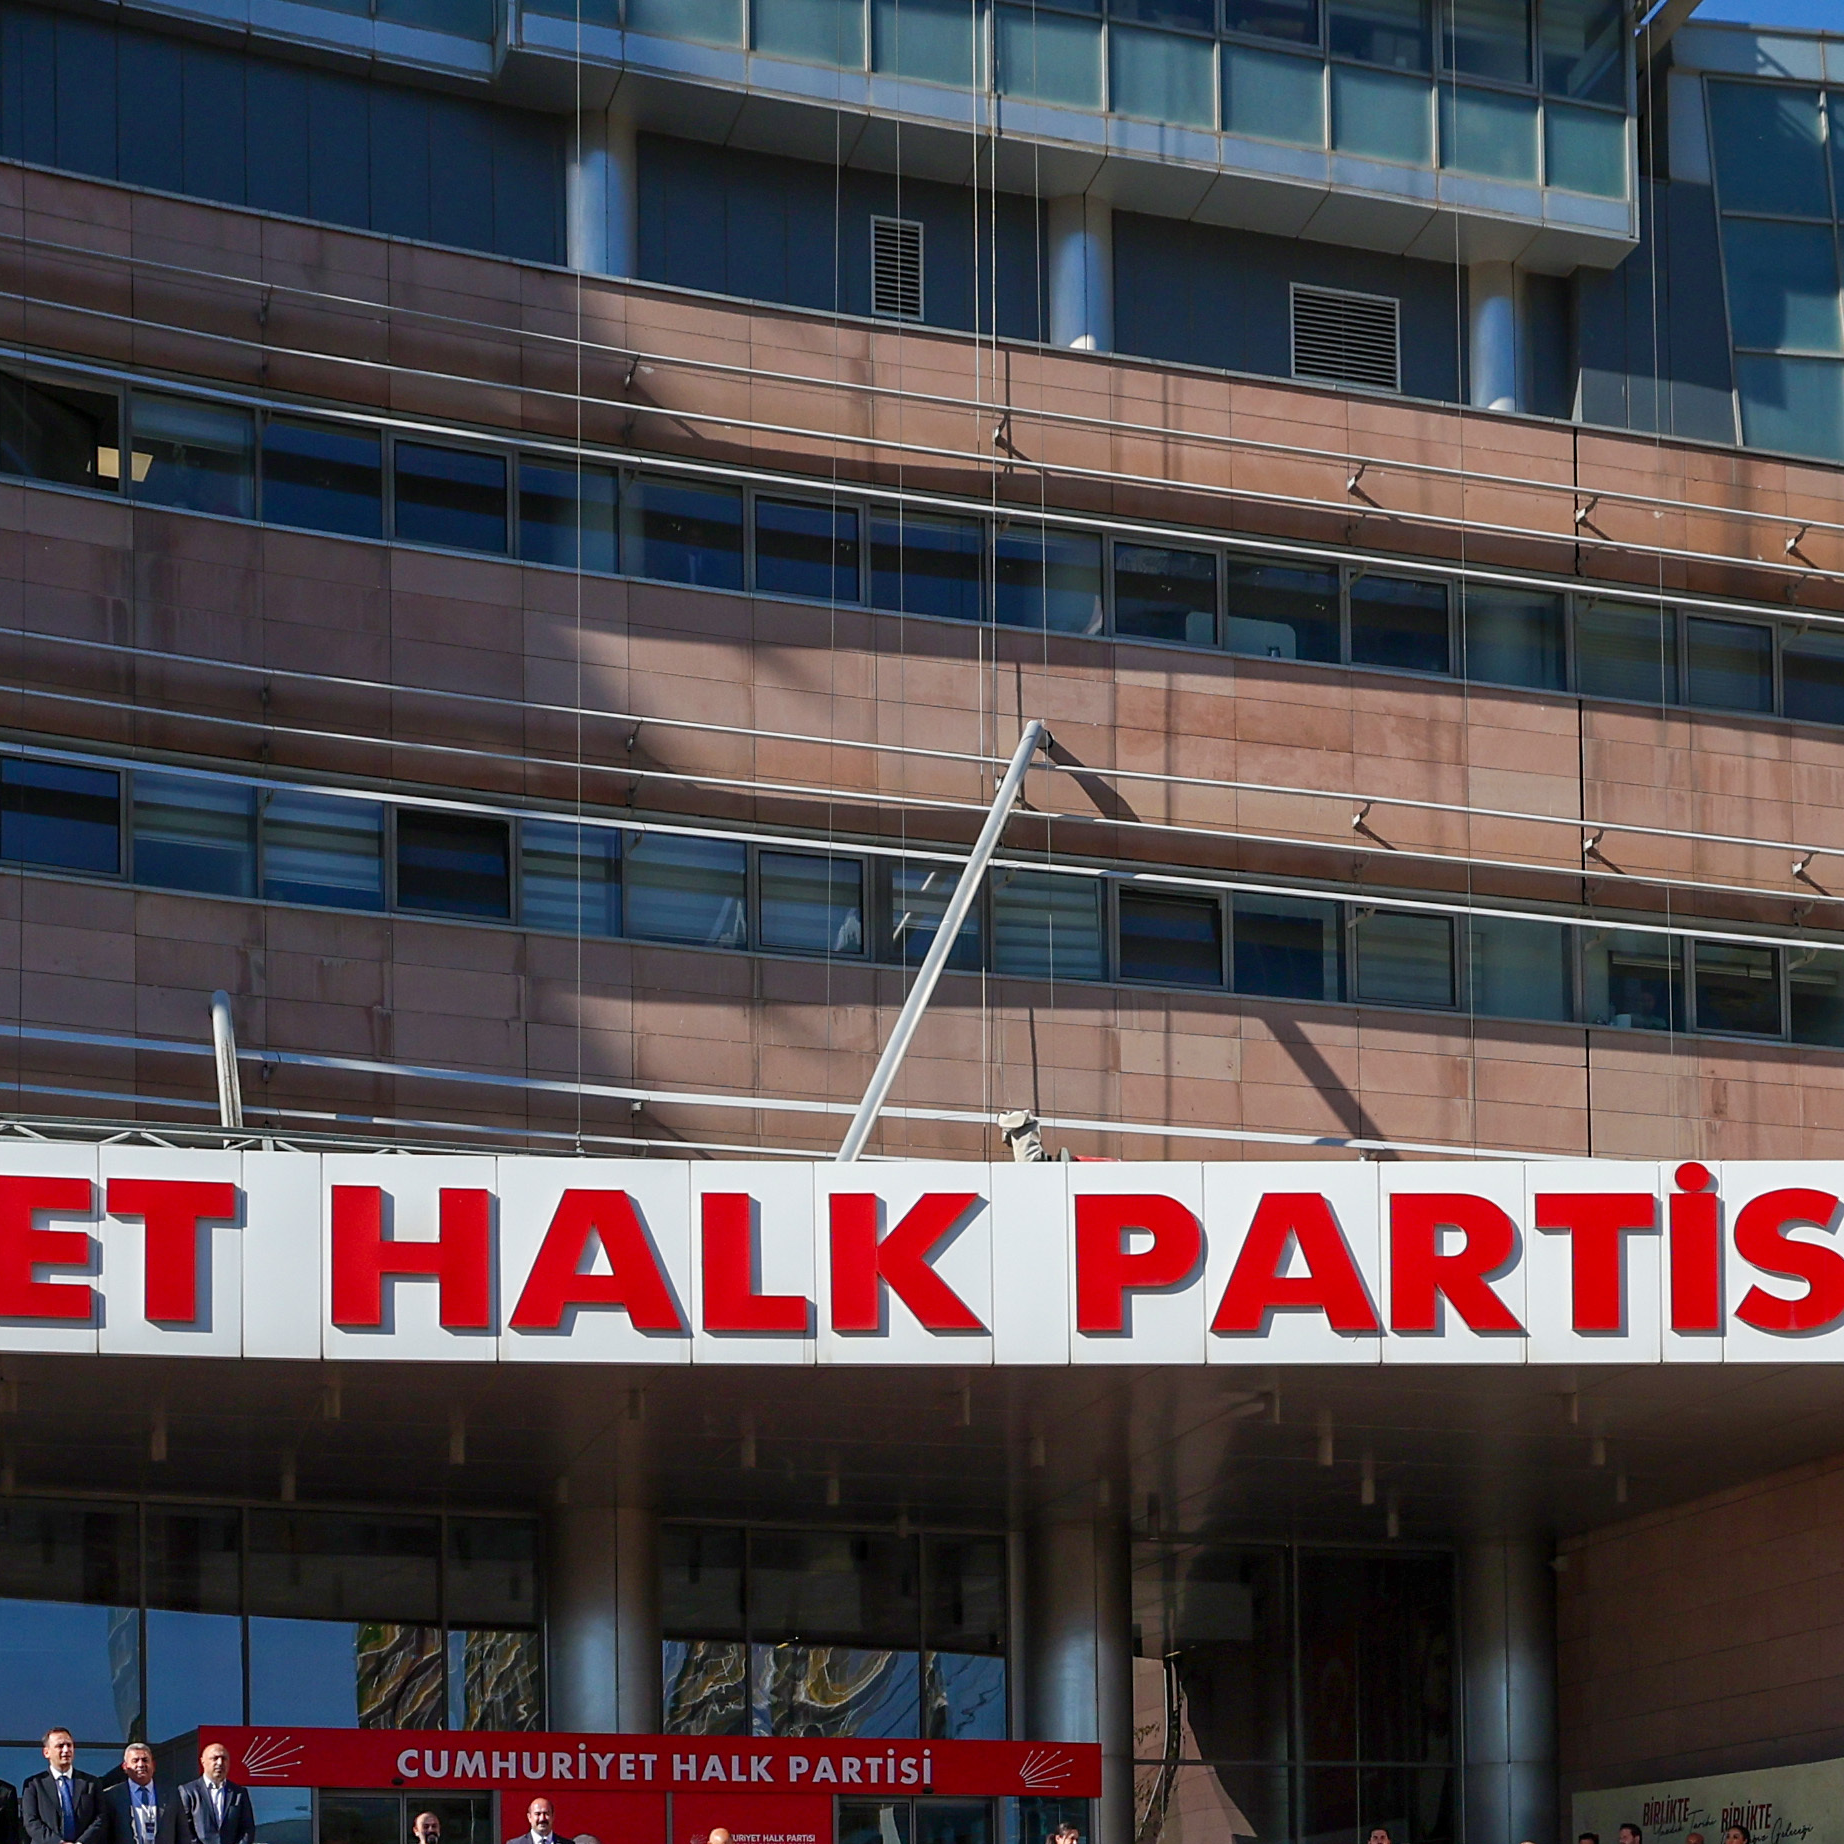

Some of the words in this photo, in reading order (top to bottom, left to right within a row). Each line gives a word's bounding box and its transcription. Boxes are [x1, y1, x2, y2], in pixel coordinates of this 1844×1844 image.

[332, 1184, 984, 1332] HALK
[397, 1743, 659, 1782] CUMHURİYET
[673, 1754, 775, 1783] HALK
[789, 1747, 932, 1785] PARTİSİ
[762, 1834, 785, 1842] HALK
